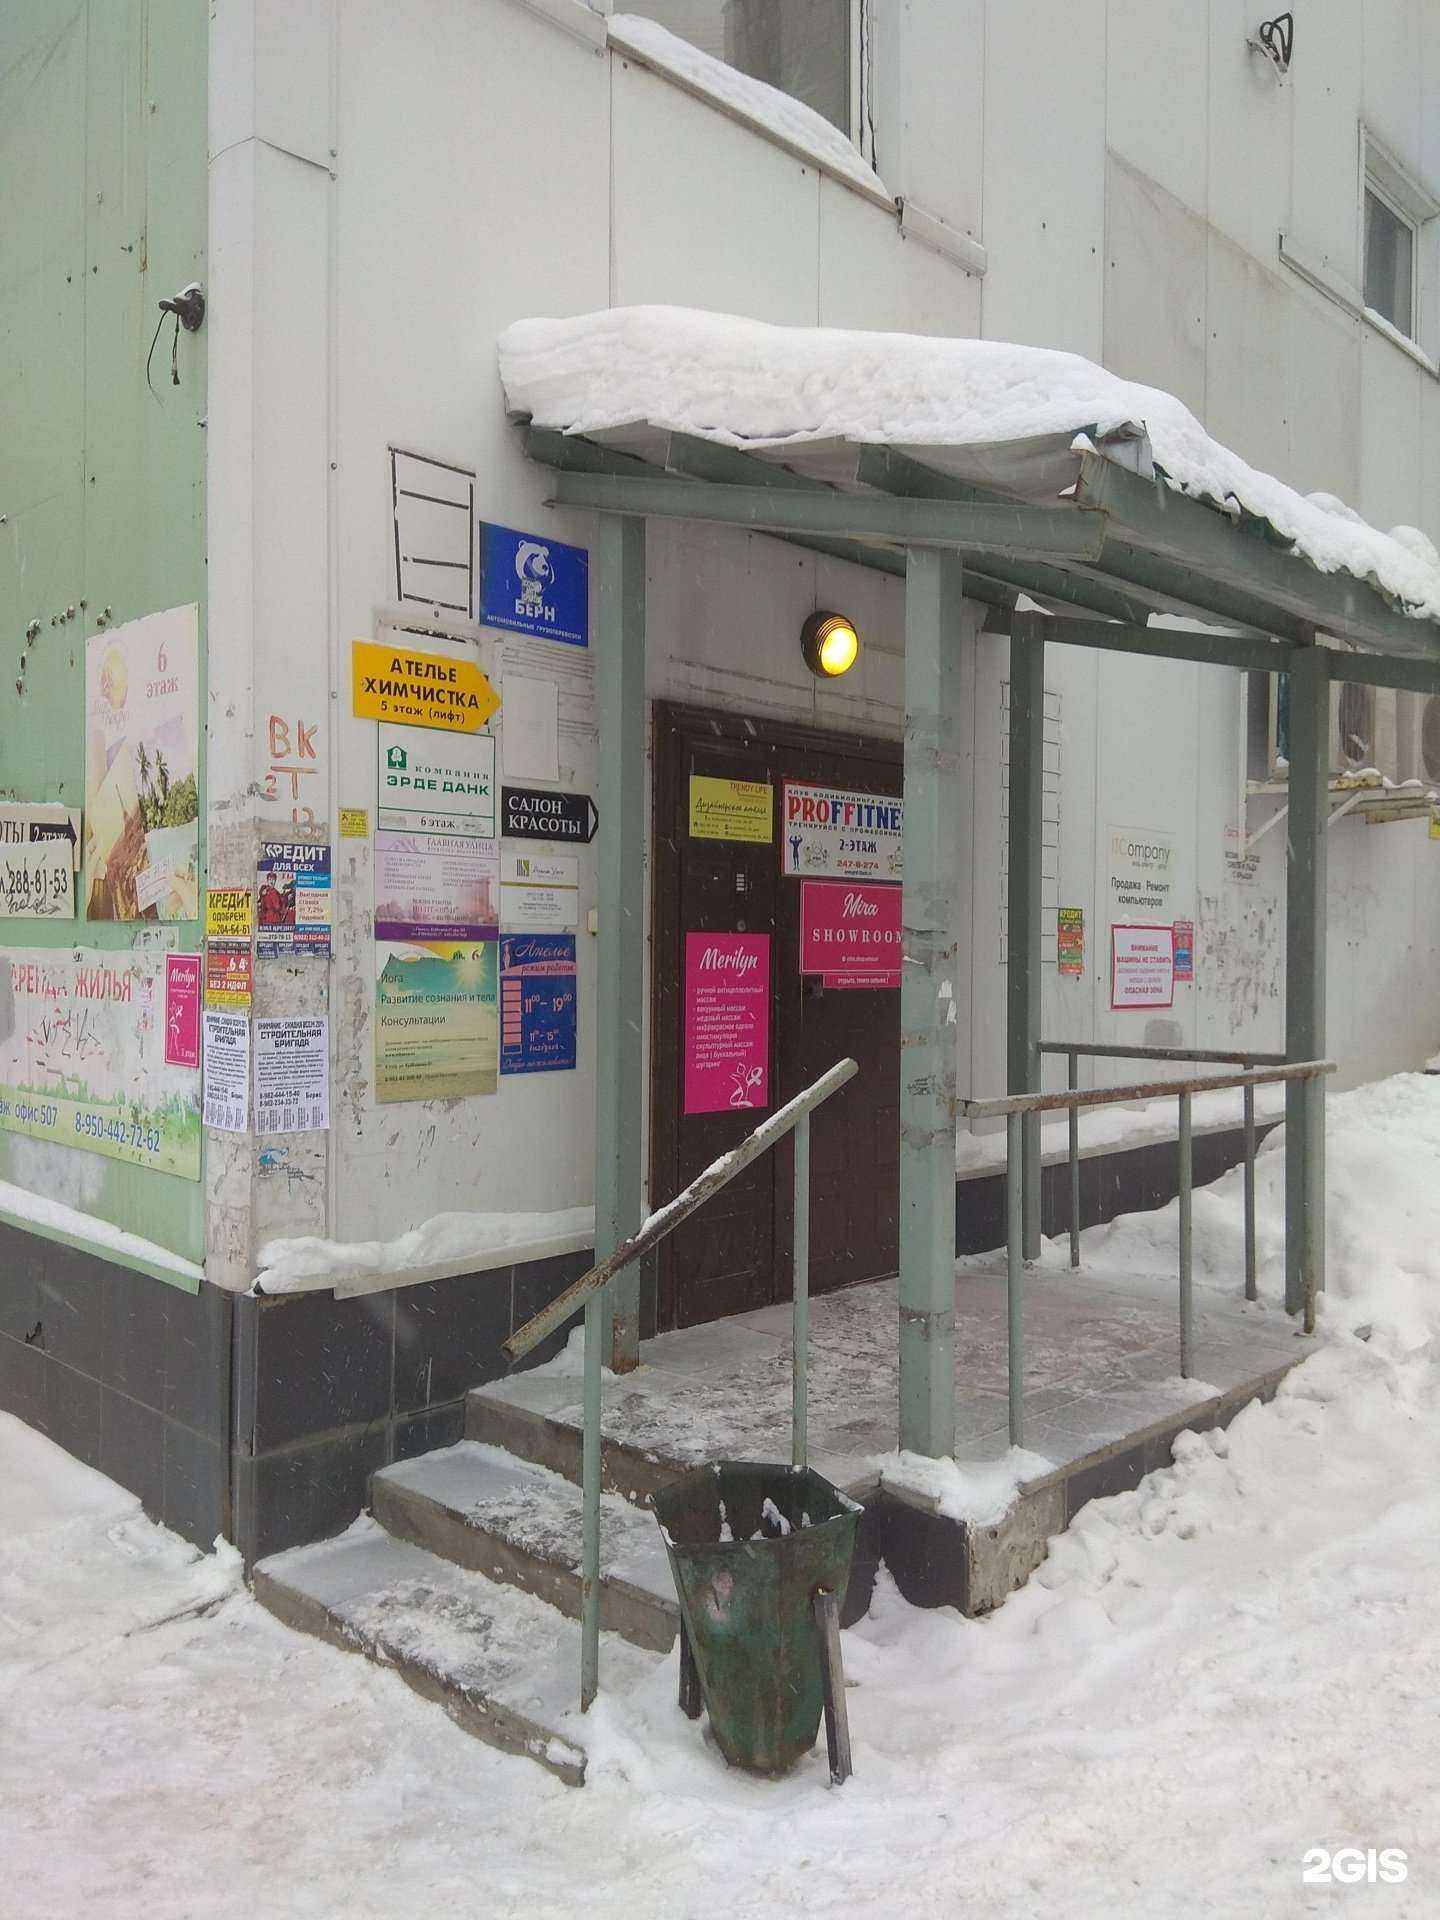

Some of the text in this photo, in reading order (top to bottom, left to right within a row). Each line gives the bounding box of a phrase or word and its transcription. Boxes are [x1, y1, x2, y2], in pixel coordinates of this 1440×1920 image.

[515, 598, 556, 623] БЕРН
[157, 640, 169, 673] 6
[390, 657, 457, 684] АТЕЛЬЕ
[145, 677, 179, 698] этаж
[364, 677, 479, 709] ХИМЧИСТКА
[381, 700, 465, 725] 5 этаж (лифт)
[415, 765, 489, 781] компания
[386, 775, 489, 796] ЭРДЕ ДАНК
[508, 795, 562, 815] САЛОН
[788, 796, 903, 831] PROFFITNE
[420, 814, 456, 829] 6 этаж
[508, 814, 582, 834] КРАСОТЫ
[264, 843, 327, 862] КРЕДИТ
[839, 838, 877, 854] 2-ЭТАЖ
[272, 862, 315, 872] ДЛЯ ВСЕХ
[1111, 876, 1141, 891] Продажа
[209, 892, 251, 911] КРЕДИТ
[842, 892, 881, 918] Mira
[212, 911, 246, 922] ОДОБРЕН!
[700, 946, 758, 978] Merilyn
[75, 967, 132, 1002] ЖИЛЬЯ
[381, 992, 496, 1005] Развитие сознания и тела
[381, 1015, 447, 1027] Консультации
[260, 1029, 322, 1040] СТРОИТЕЛЬНАЯ
[274, 1039, 310, 1048] БРИГАДА
[15, 1103, 38, 1125] офис
[40, 1104, 58, 1128] 507
[75, 1111, 160, 1153] 8-950-442-72-62
